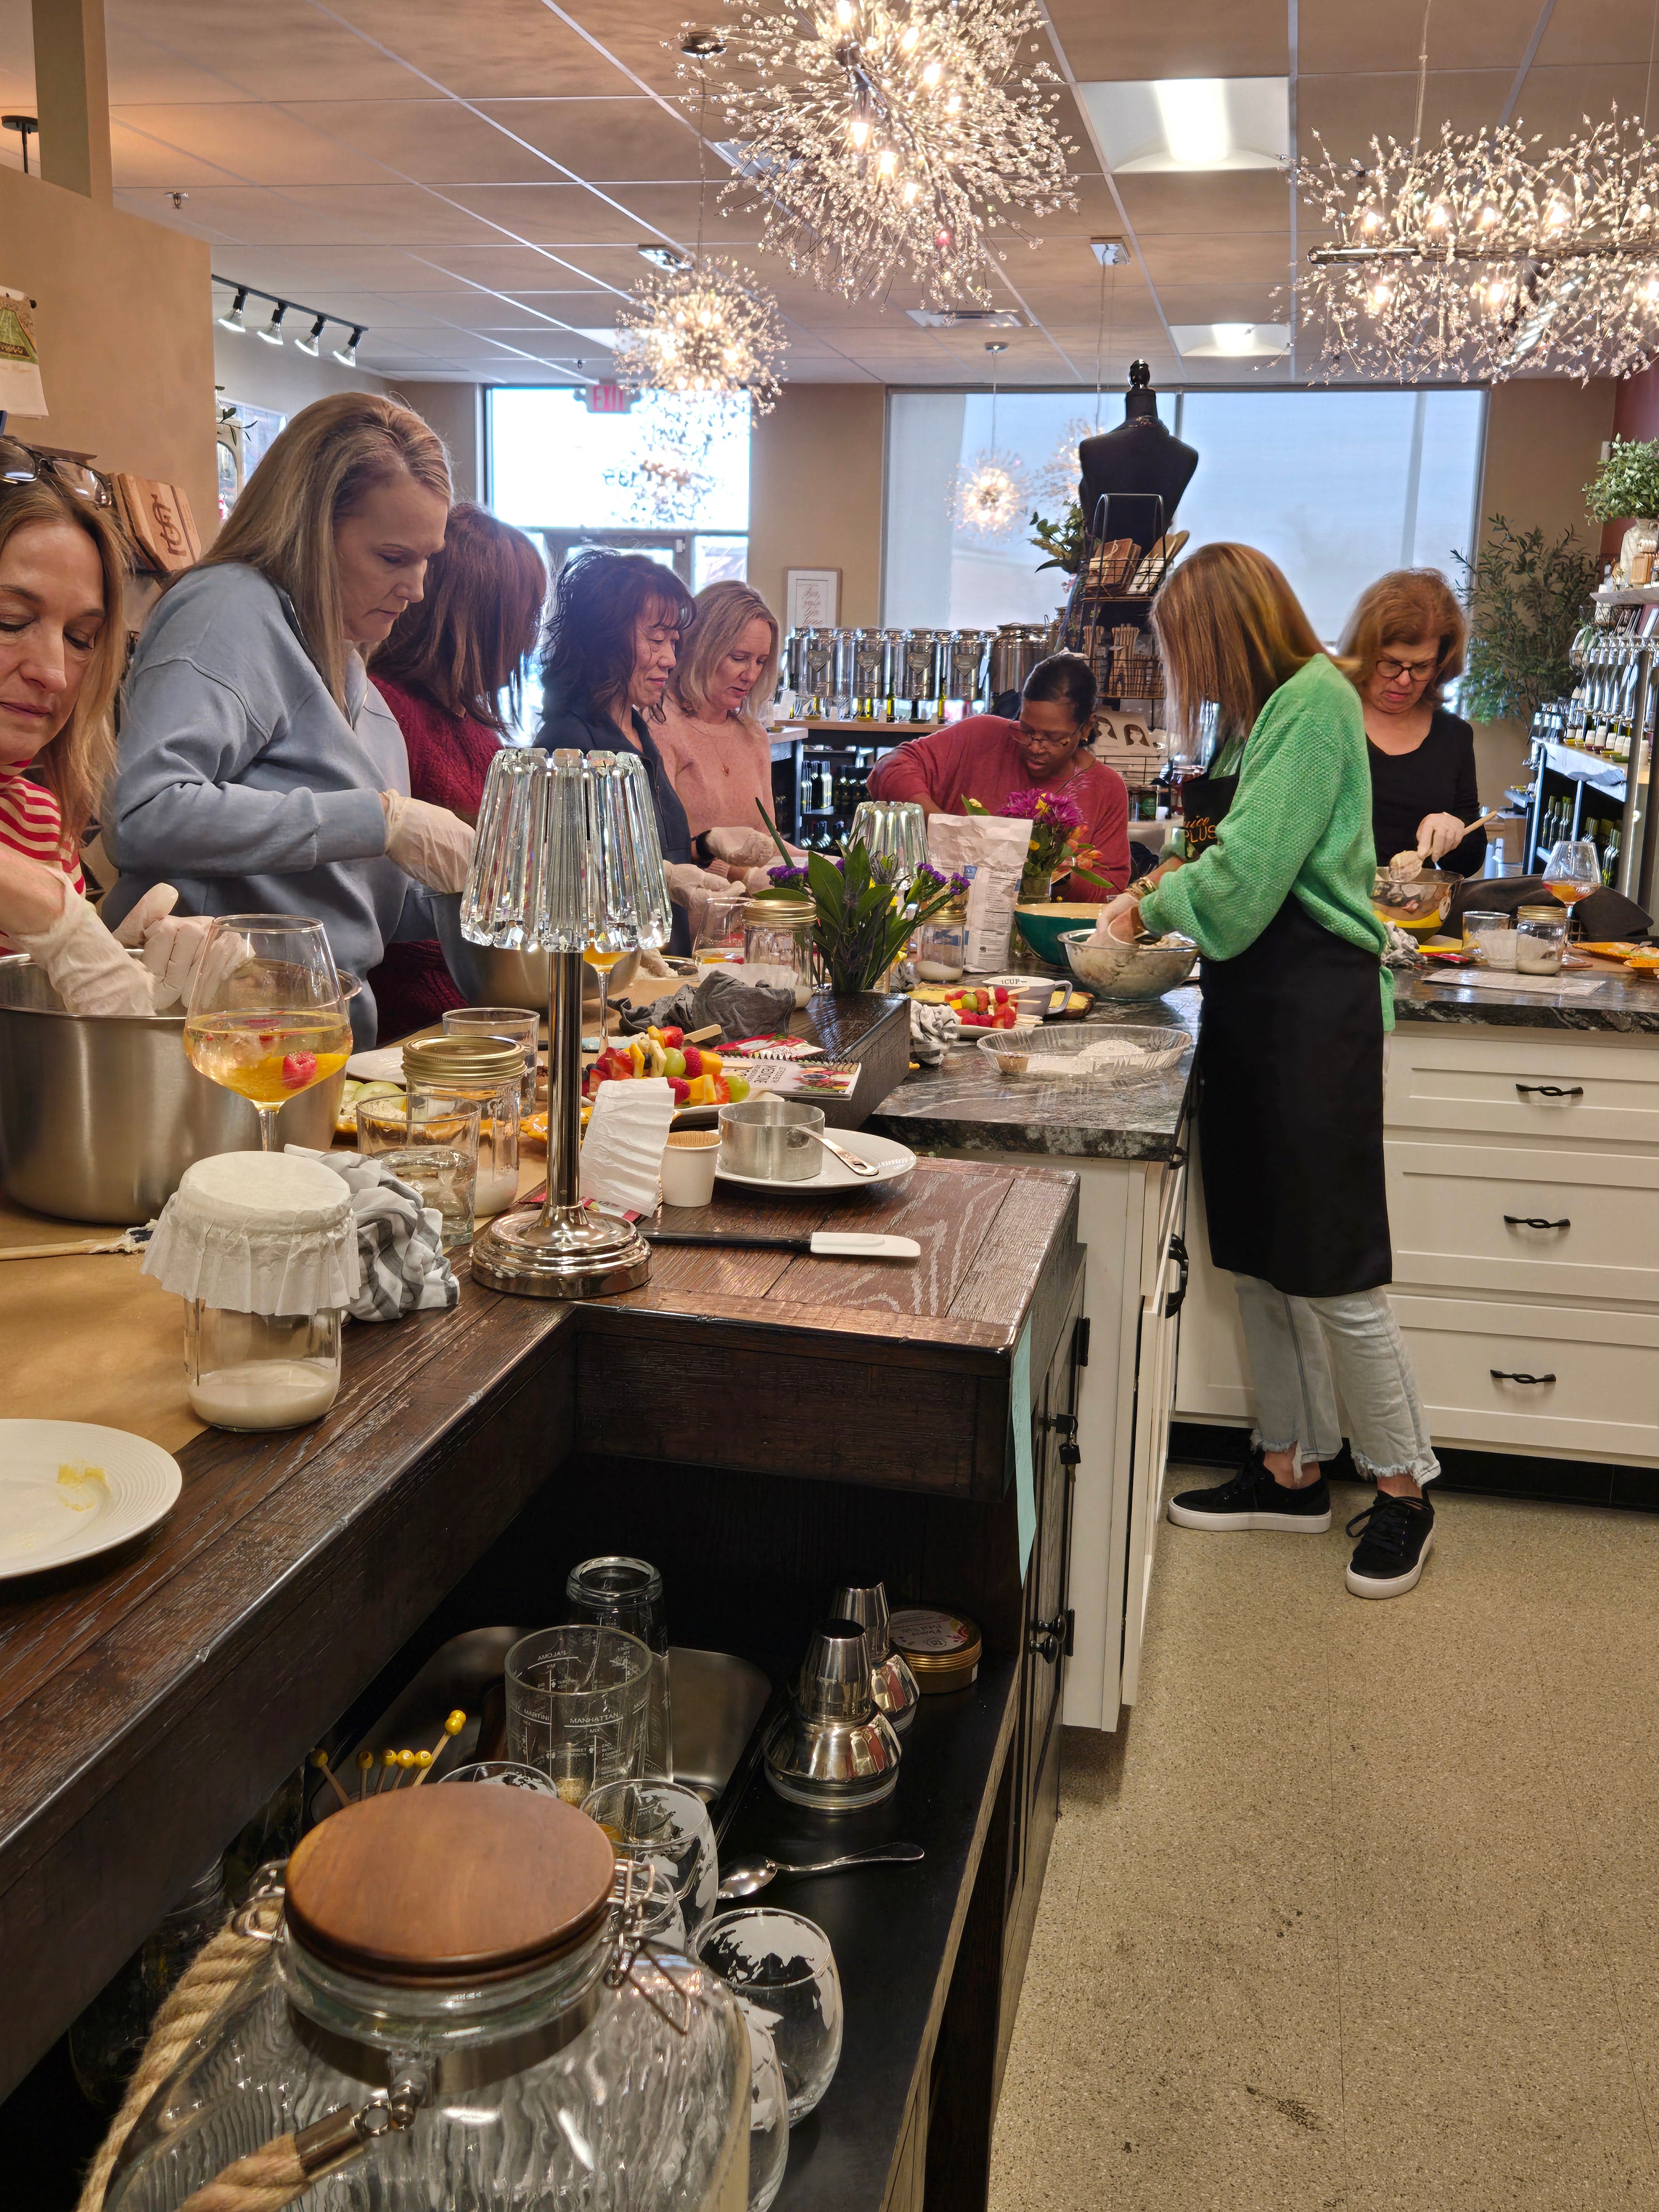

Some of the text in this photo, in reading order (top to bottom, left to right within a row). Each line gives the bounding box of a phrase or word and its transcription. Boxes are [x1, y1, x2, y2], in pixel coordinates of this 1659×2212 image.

[593, 385, 623, 411] EXIT
[524, 1708, 550, 1721] MARTINI
[570, 1712, 618, 1724] MANHATTAN
